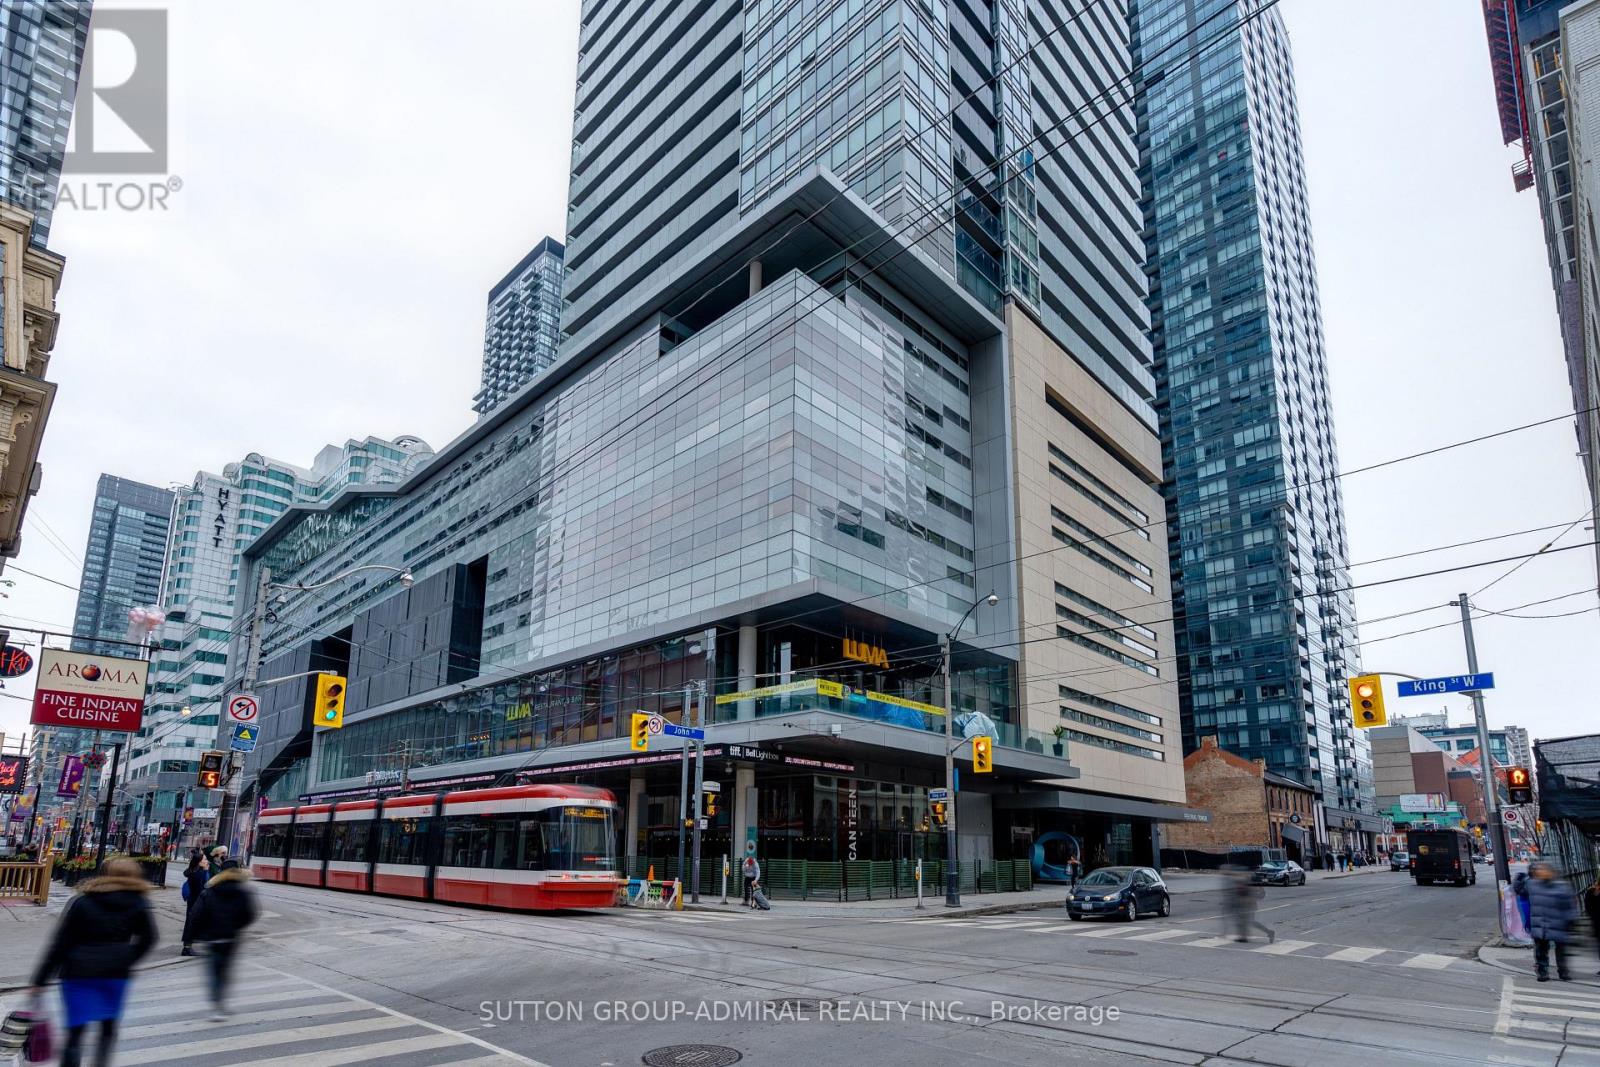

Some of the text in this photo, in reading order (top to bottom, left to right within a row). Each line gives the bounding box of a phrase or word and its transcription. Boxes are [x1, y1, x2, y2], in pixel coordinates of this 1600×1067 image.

[213, 488, 229, 548] HYATT
[842, 638, 890, 669] LUMA
[48, 662, 139, 685] AROMA
[1413, 680, 1447, 692] King
[1462, 675, 1475, 687] W
[42, 693, 137, 713] FINE INDIAN
[56, 707, 120, 723] CUISINE
[674, 726, 690, 736] John
